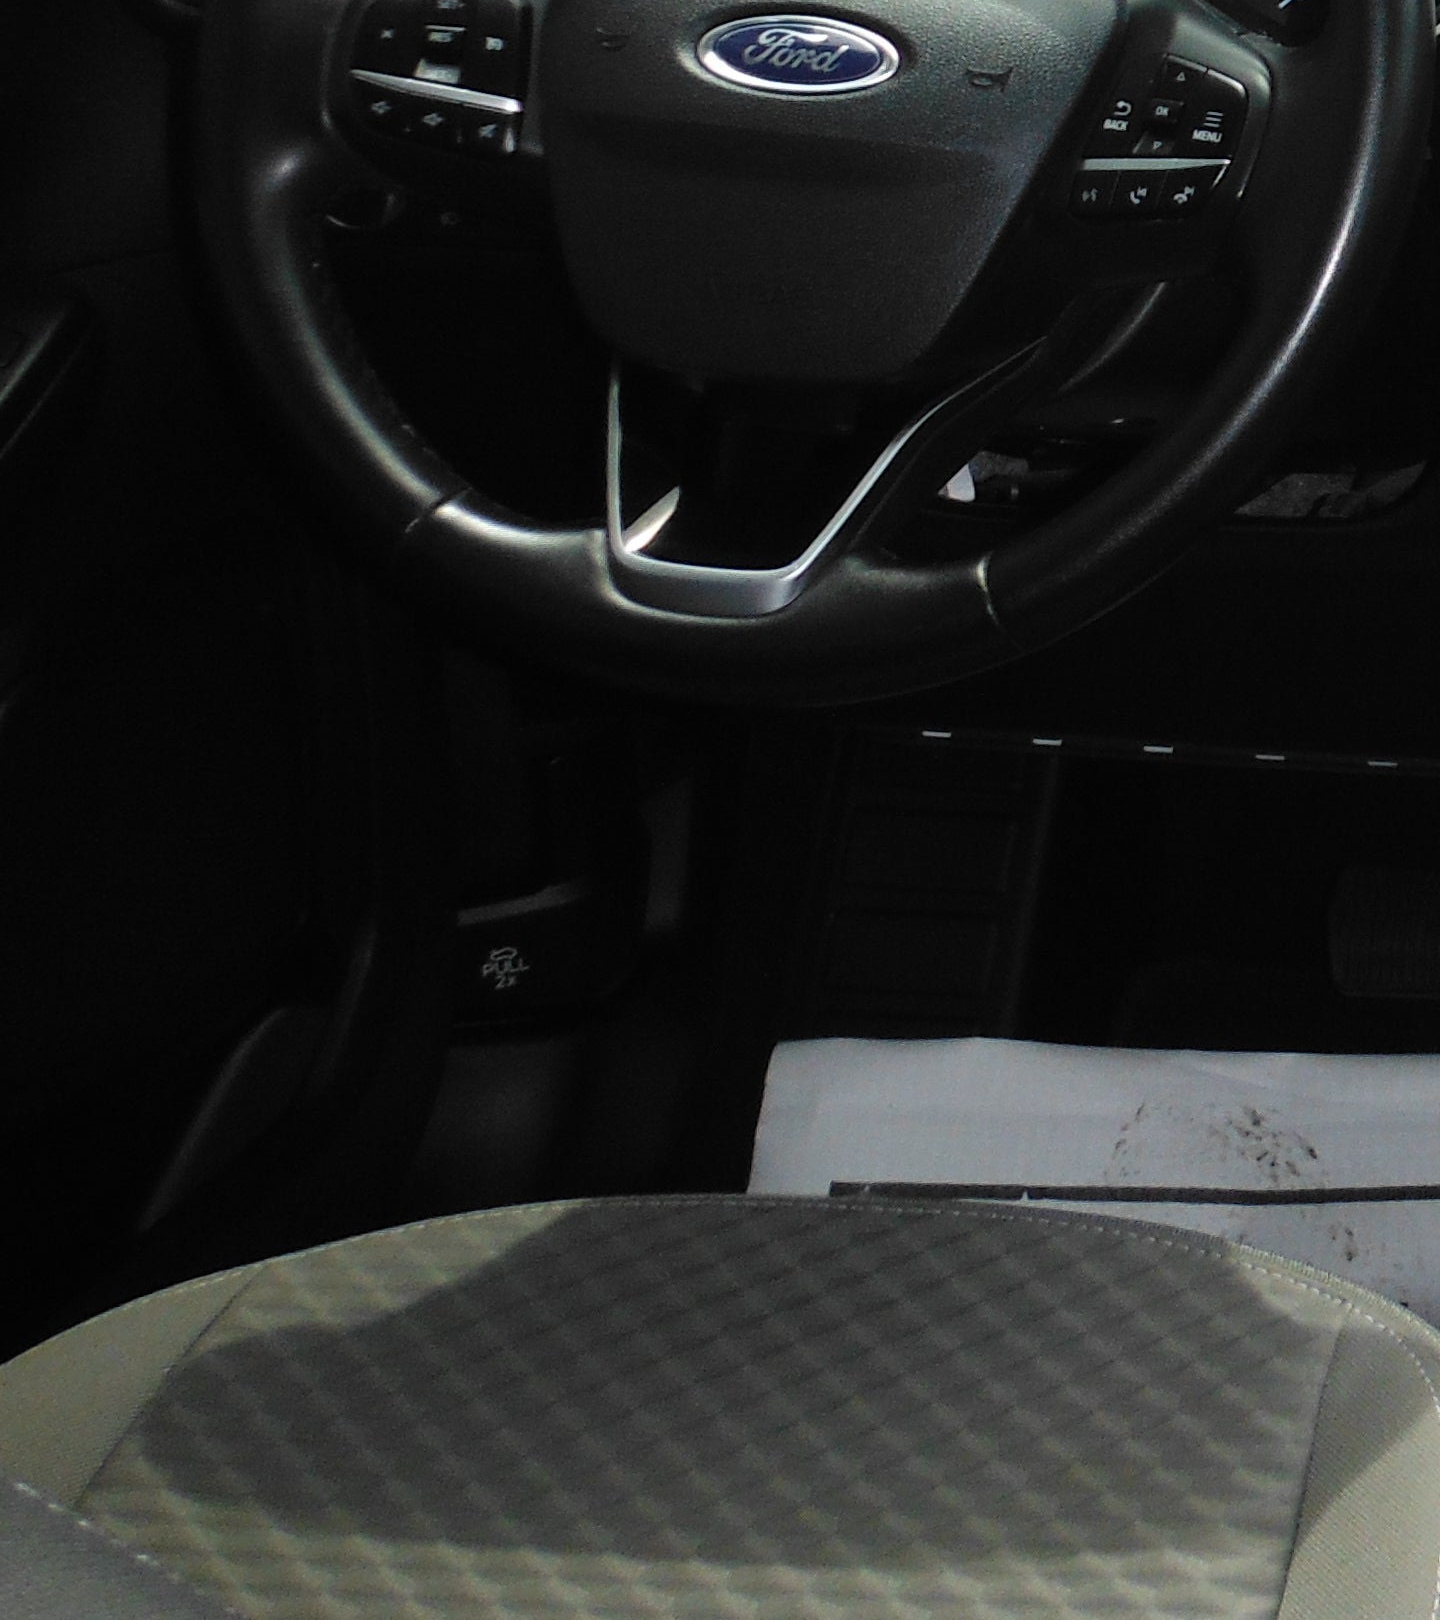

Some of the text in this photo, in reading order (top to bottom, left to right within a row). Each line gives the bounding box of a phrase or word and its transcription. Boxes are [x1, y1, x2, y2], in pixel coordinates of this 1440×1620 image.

[742, 28, 850, 74] Ford
[1155, 105, 1169, 117] OK
[1102, 118, 1130, 132] BACK
[1191, 129, 1223, 144] MENU
[481, 957, 530, 978] PULL
